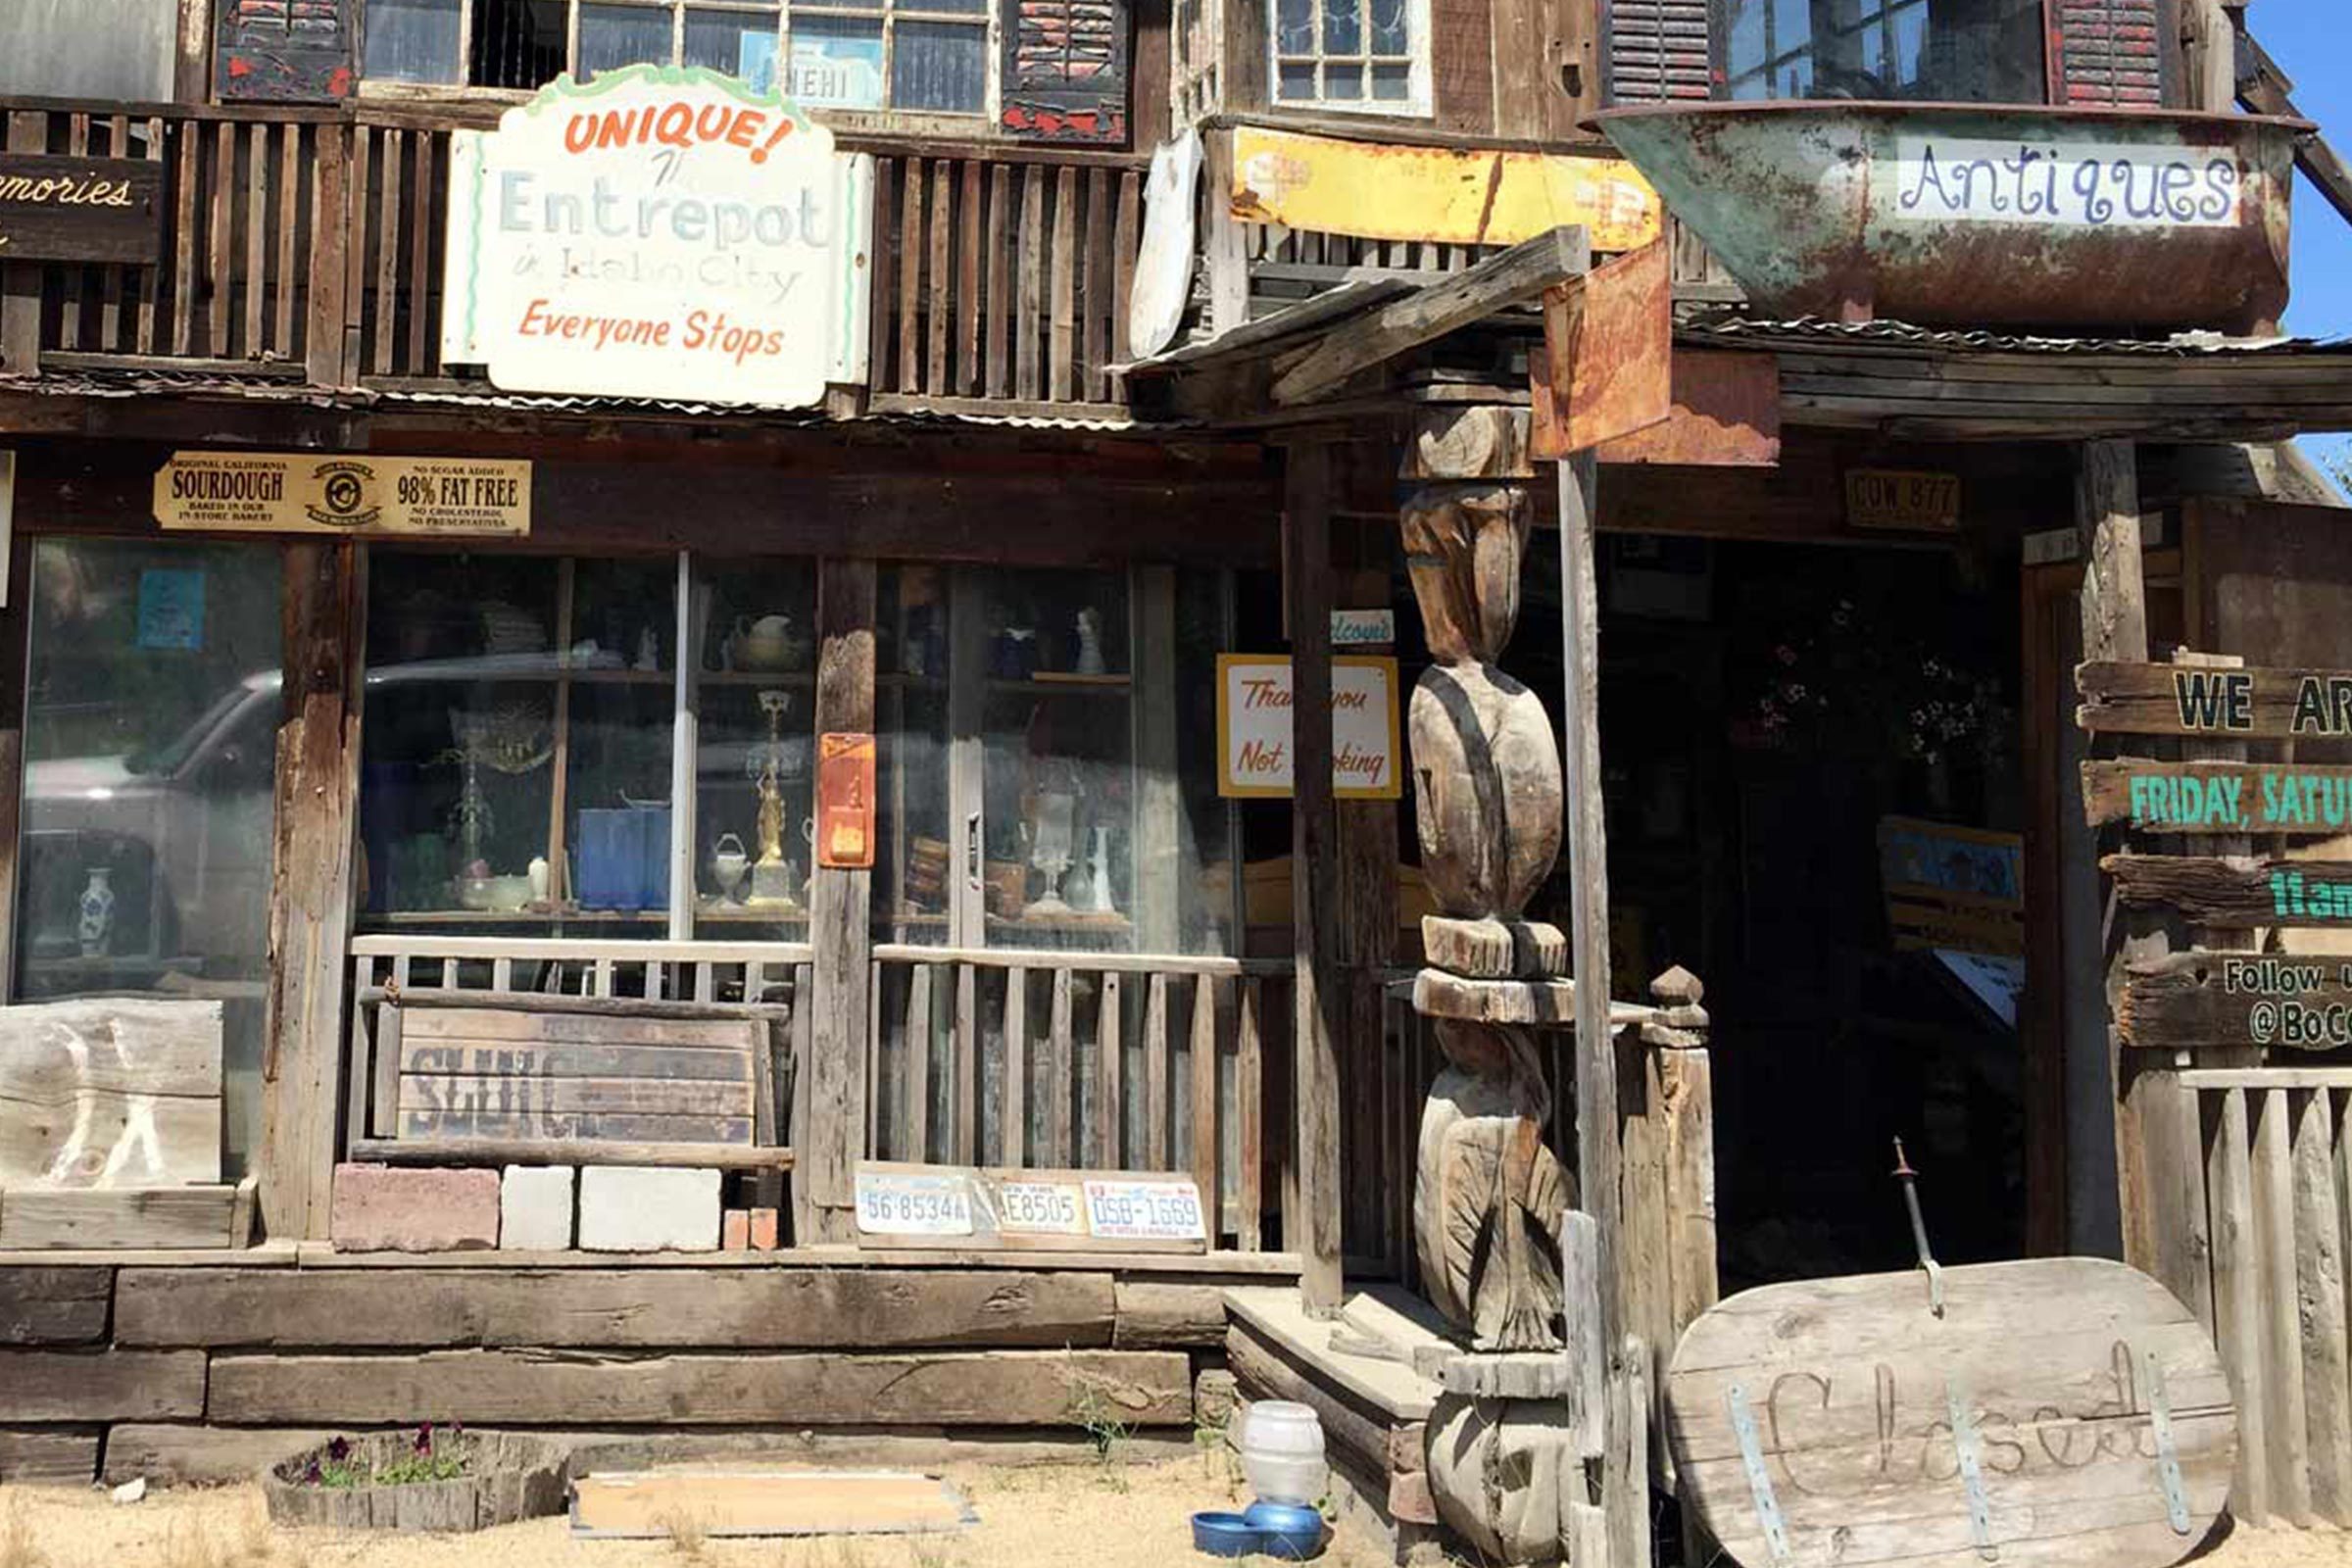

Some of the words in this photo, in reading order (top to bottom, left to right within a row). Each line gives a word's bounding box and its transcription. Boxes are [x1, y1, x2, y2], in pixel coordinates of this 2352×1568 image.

[564, 101, 794, 165] UNIQUE!
[0, 172, 133, 206] mories
[1900, 144, 2235, 224] Antiques
[499, 170, 831, 251] Entrepot
[696, 254, 805, 304] City
[517, 298, 671, 351] Everyone
[682, 309, 786, 366] Stops
[172, 469, 284, 501] SOURDOUGH
[223, 461, 287, 470] CALIFORNIA
[430, 466, 466, 475] SUGAR
[468, 466, 505, 476] ADDED
[397, 475, 437, 506] 98%
[440, 477, 471, 507] FAT
[474, 478, 519, 508] FREE
[1331, 614, 1389, 641] lcome
[1241, 679, 1293, 710] Tha
[1329, 690, 1367, 711] you
[2172, 670, 2254, 731] WE
[1238, 740, 1285, 773] Not
[1333, 741, 1385, 784] king
[2129, 775, 2250, 830] FRIDAY,
[2263, 772, 2352, 826] SATU
[2224, 959, 2324, 996] Follow
[2249, 1001, 2352, 1045] @BoC
[1767, 1339, 2161, 1497] Closed
